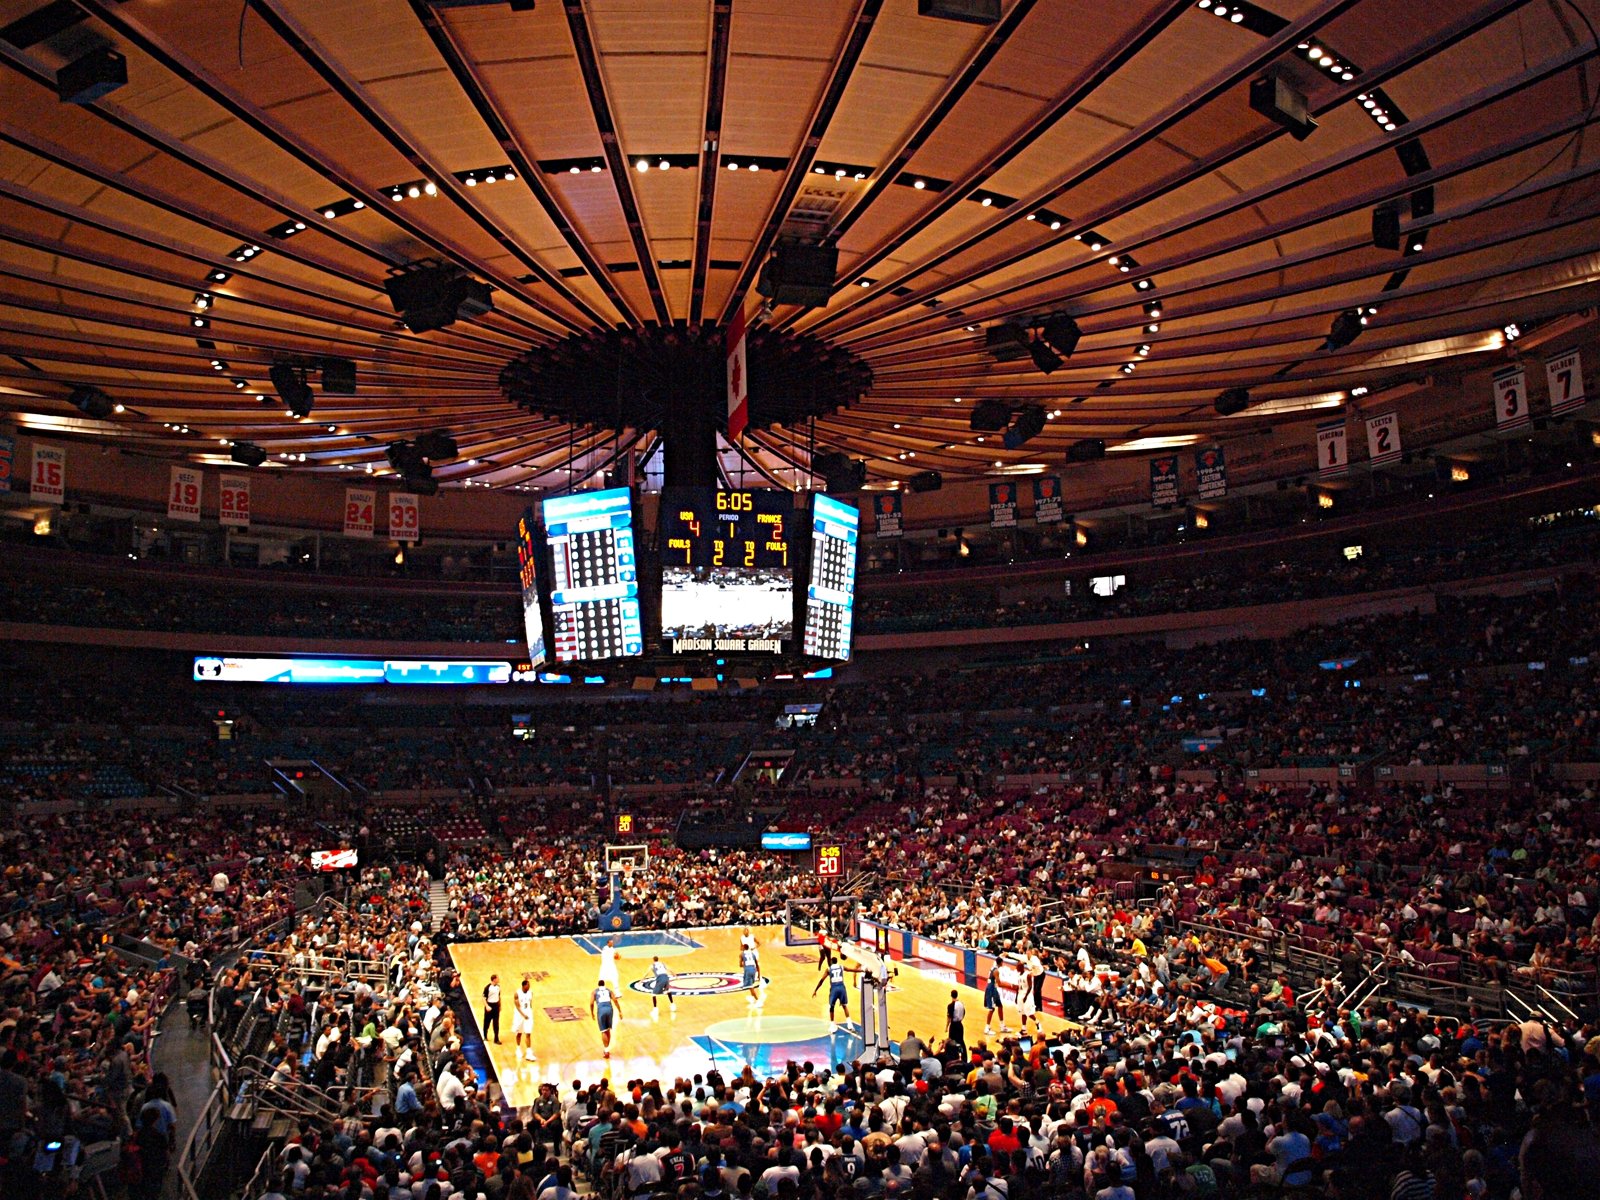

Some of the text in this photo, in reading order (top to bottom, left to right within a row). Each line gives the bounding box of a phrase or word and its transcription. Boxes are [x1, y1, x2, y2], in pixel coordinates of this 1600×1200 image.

[1557, 370, 1571, 399] 7
[1504, 389, 1518, 417] 3
[1376, 427, 1391, 453] 2
[1328, 441, 1337, 465] 1
[36, 461, 62, 486] 15
[174, 482, 198, 505] 19
[221, 490, 249, 512] 22
[716, 492, 752, 511] 6:05
[347, 503, 373, 524] 24
[391, 505, 417, 528] 33
[680, 511, 694, 520] USA
[757, 514, 782, 523] FRANCE
[689, 521, 700, 537] 4
[730, 522, 735, 538] 1
[772, 523, 783, 540] 2
[668, 539, 691, 548] FOULS
[713, 540, 724, 550] TO
[744, 541, 755, 551] TO
[766, 542, 787, 551] FOULS
[686, 548, 691, 564] 1
[713, 550, 724, 566] 2
[744, 551, 755, 566] 2
[782, 551, 787, 566] 1
[673, 638, 782, 654] MADISON SQUARE GARDEN
[618, 822, 630, 832] 20
[821, 847, 840, 857] 6:05
[819, 857, 838, 874] 20
[674, 1162, 685, 1178] 7
